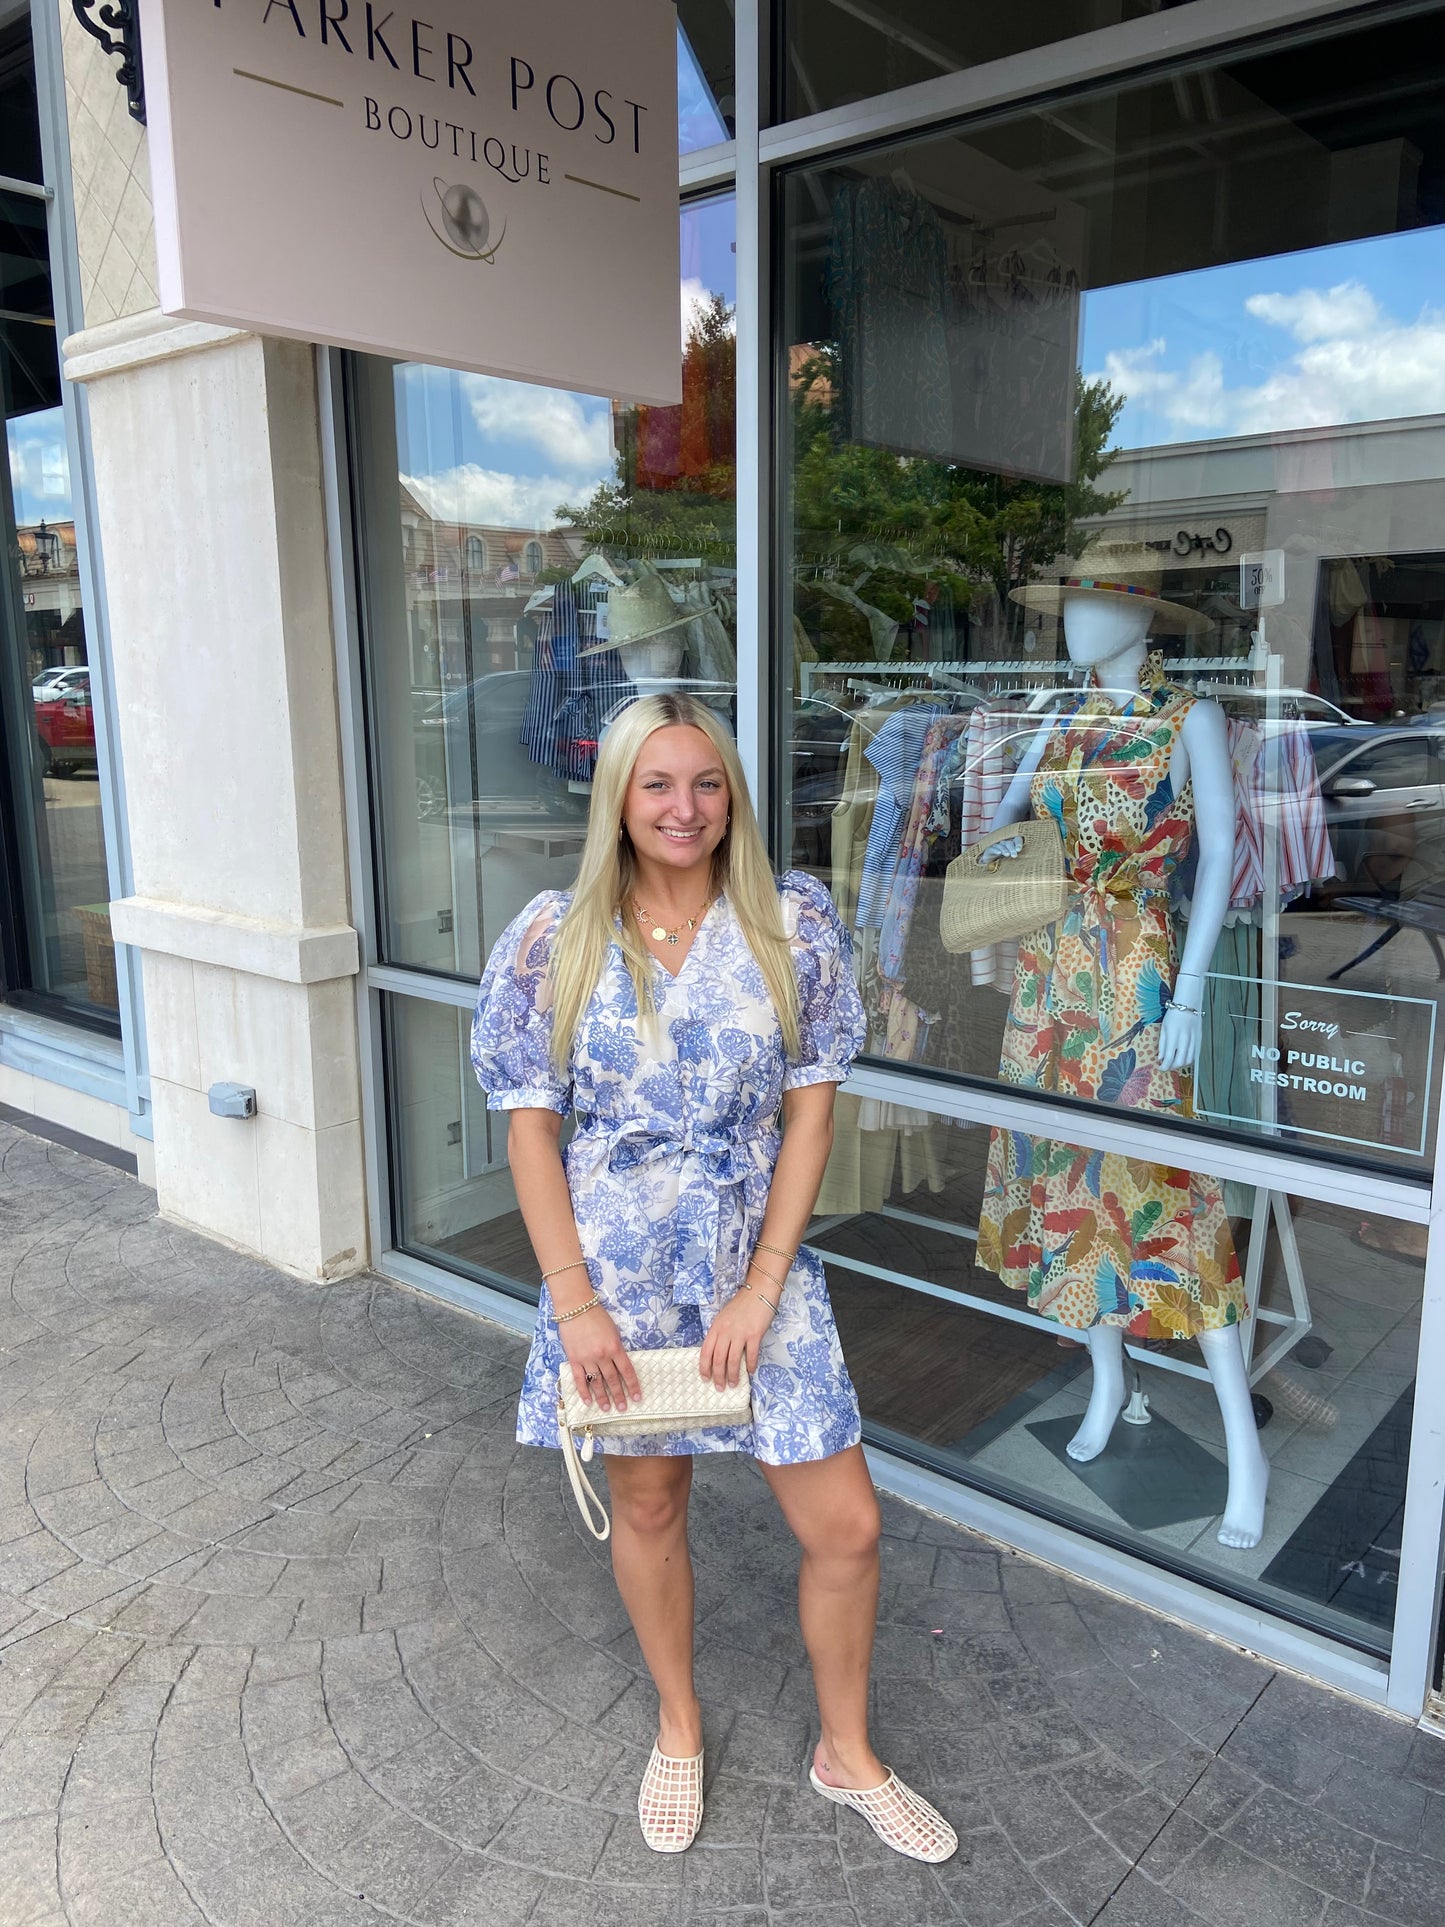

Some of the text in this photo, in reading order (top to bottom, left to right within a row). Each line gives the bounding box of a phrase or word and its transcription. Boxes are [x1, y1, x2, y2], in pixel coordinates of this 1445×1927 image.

[213, 0, 648, 154] ARKER POST
[364, 96, 551, 184] BOUTIQUE
[1251, 568, 1273, 586] 50%
[1280, 1011, 1340, 1041] Sorry
[1250, 1044, 1367, 1076] NO PUBLIC
[1249, 1067, 1368, 1102] RESTROOM
